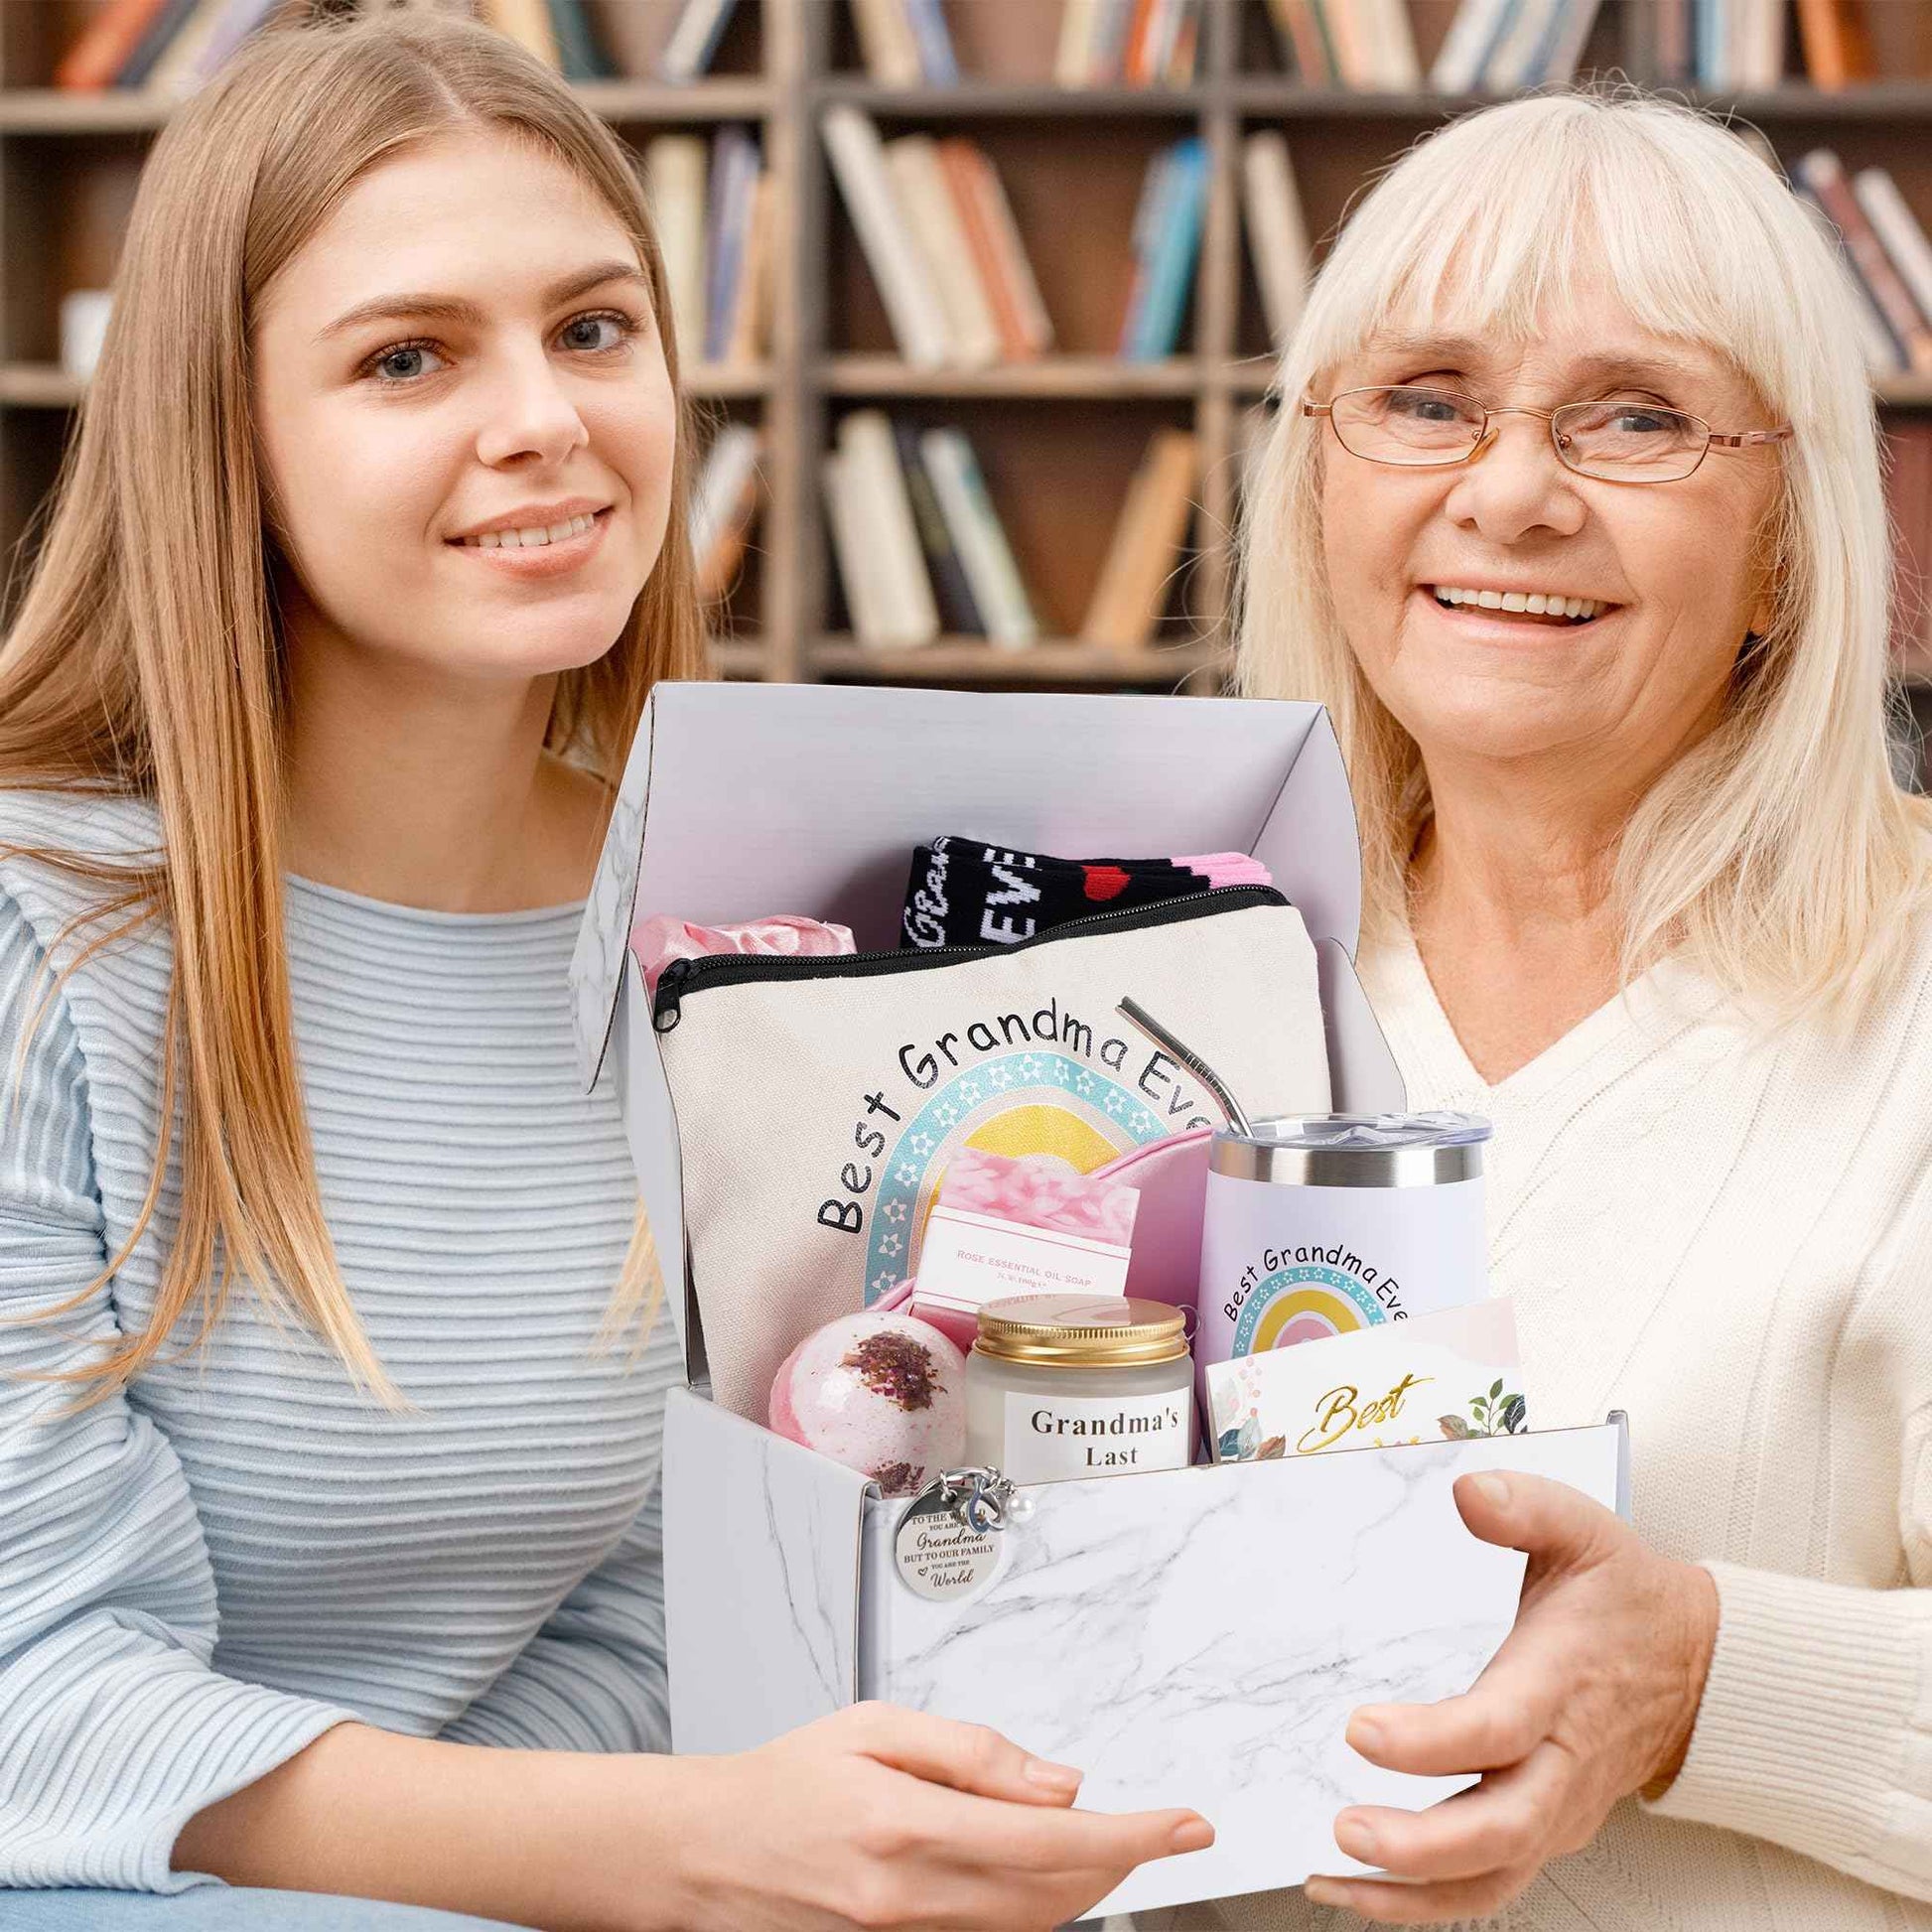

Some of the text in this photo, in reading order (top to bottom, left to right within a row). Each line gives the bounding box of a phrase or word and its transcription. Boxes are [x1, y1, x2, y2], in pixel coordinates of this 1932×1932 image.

[817, 1090, 901, 1234] Best
[898, 997, 1129, 1089] Grandma
[957, 1250, 1092, 1288] ROSE ESSENTIAL OIL SOAP
[1223, 1266, 1259, 1322] Best
[1264, 1244, 1378, 1284] Grandma
[1031, 1407, 1178, 1436] Grandma's
[1297, 1373, 1435, 1452] Best
[1086, 1447, 1139, 1466] Last
[912, 1516, 924, 1526] TO
[926, 1513, 947, 1523] THE
[917, 1529, 987, 1550] Grandma
[903, 1545, 994, 1564] BUT TO OUR FAMILY
[930, 1569, 975, 1587] World
